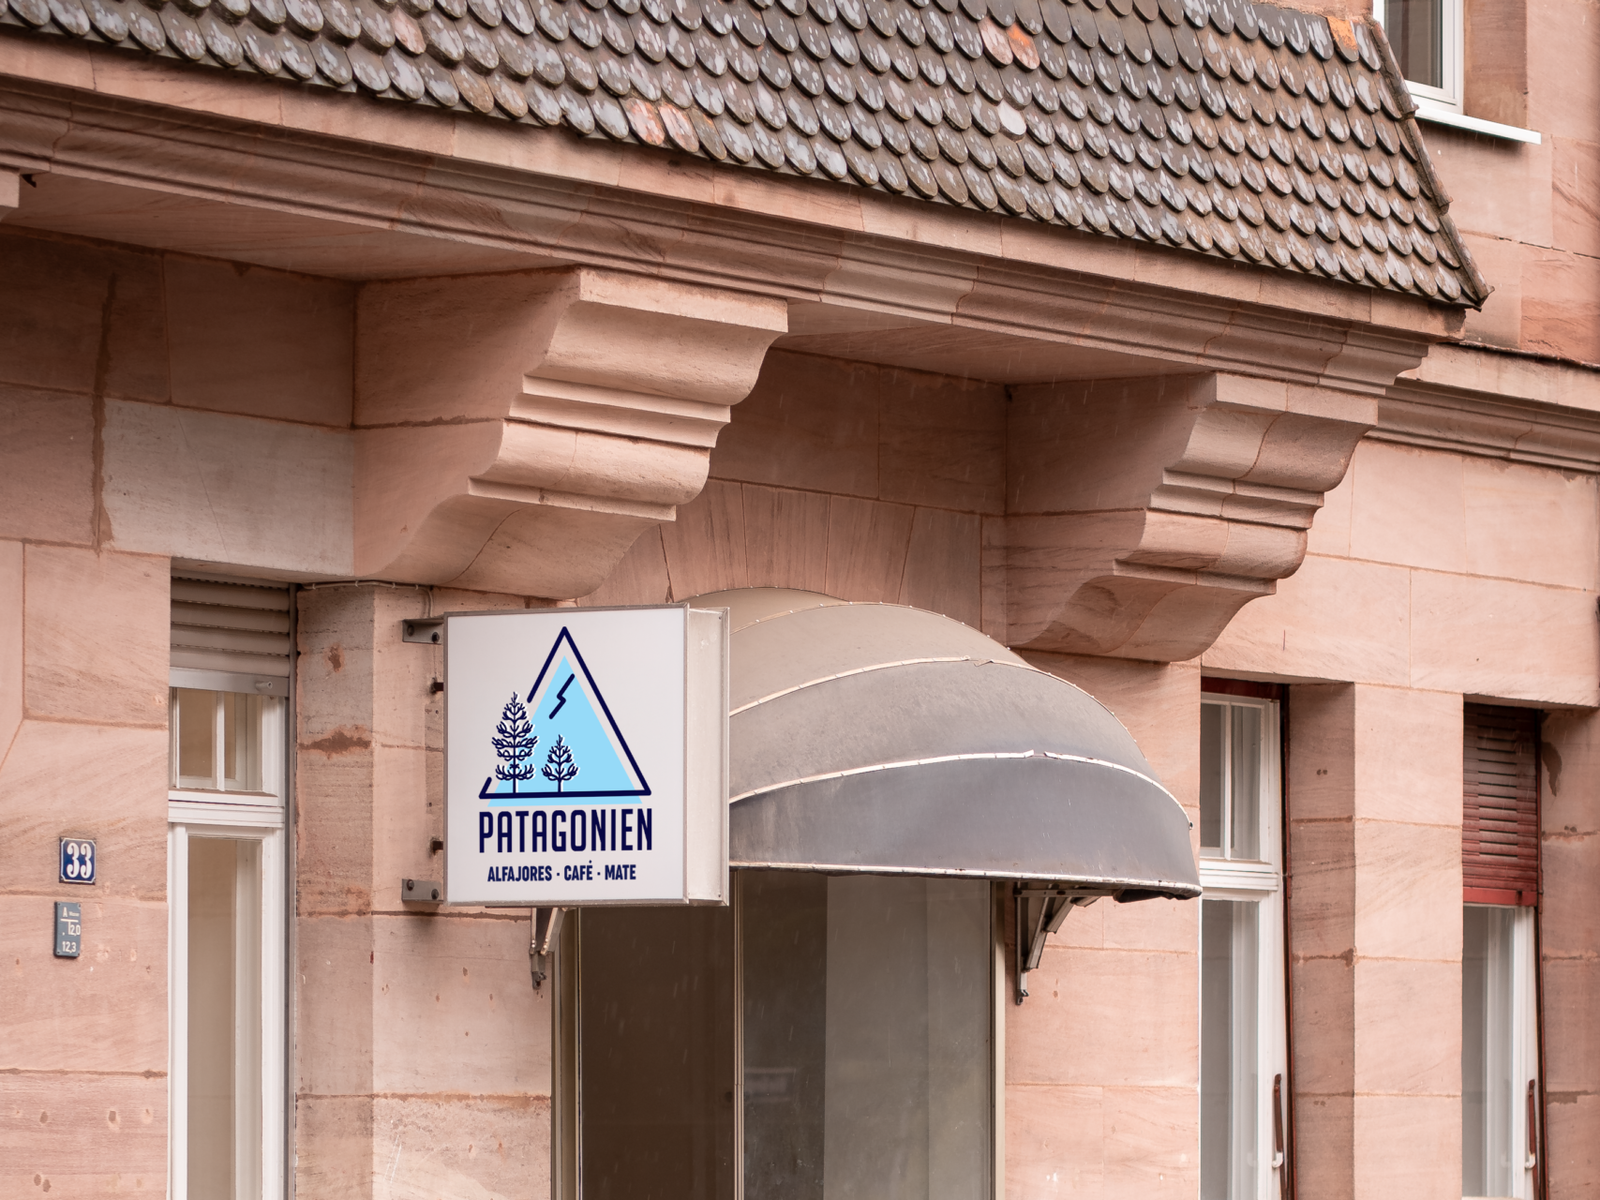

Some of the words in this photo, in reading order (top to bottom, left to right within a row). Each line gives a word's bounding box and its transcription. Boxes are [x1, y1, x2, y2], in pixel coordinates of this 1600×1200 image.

[479, 808, 652, 853] PATAGONIEN
[66, 842, 92, 879] 33
[487, 865, 552, 882] ALFAJORES
[564, 860, 593, 881] CAFÉ
[604, 864, 637, 880] MATE
